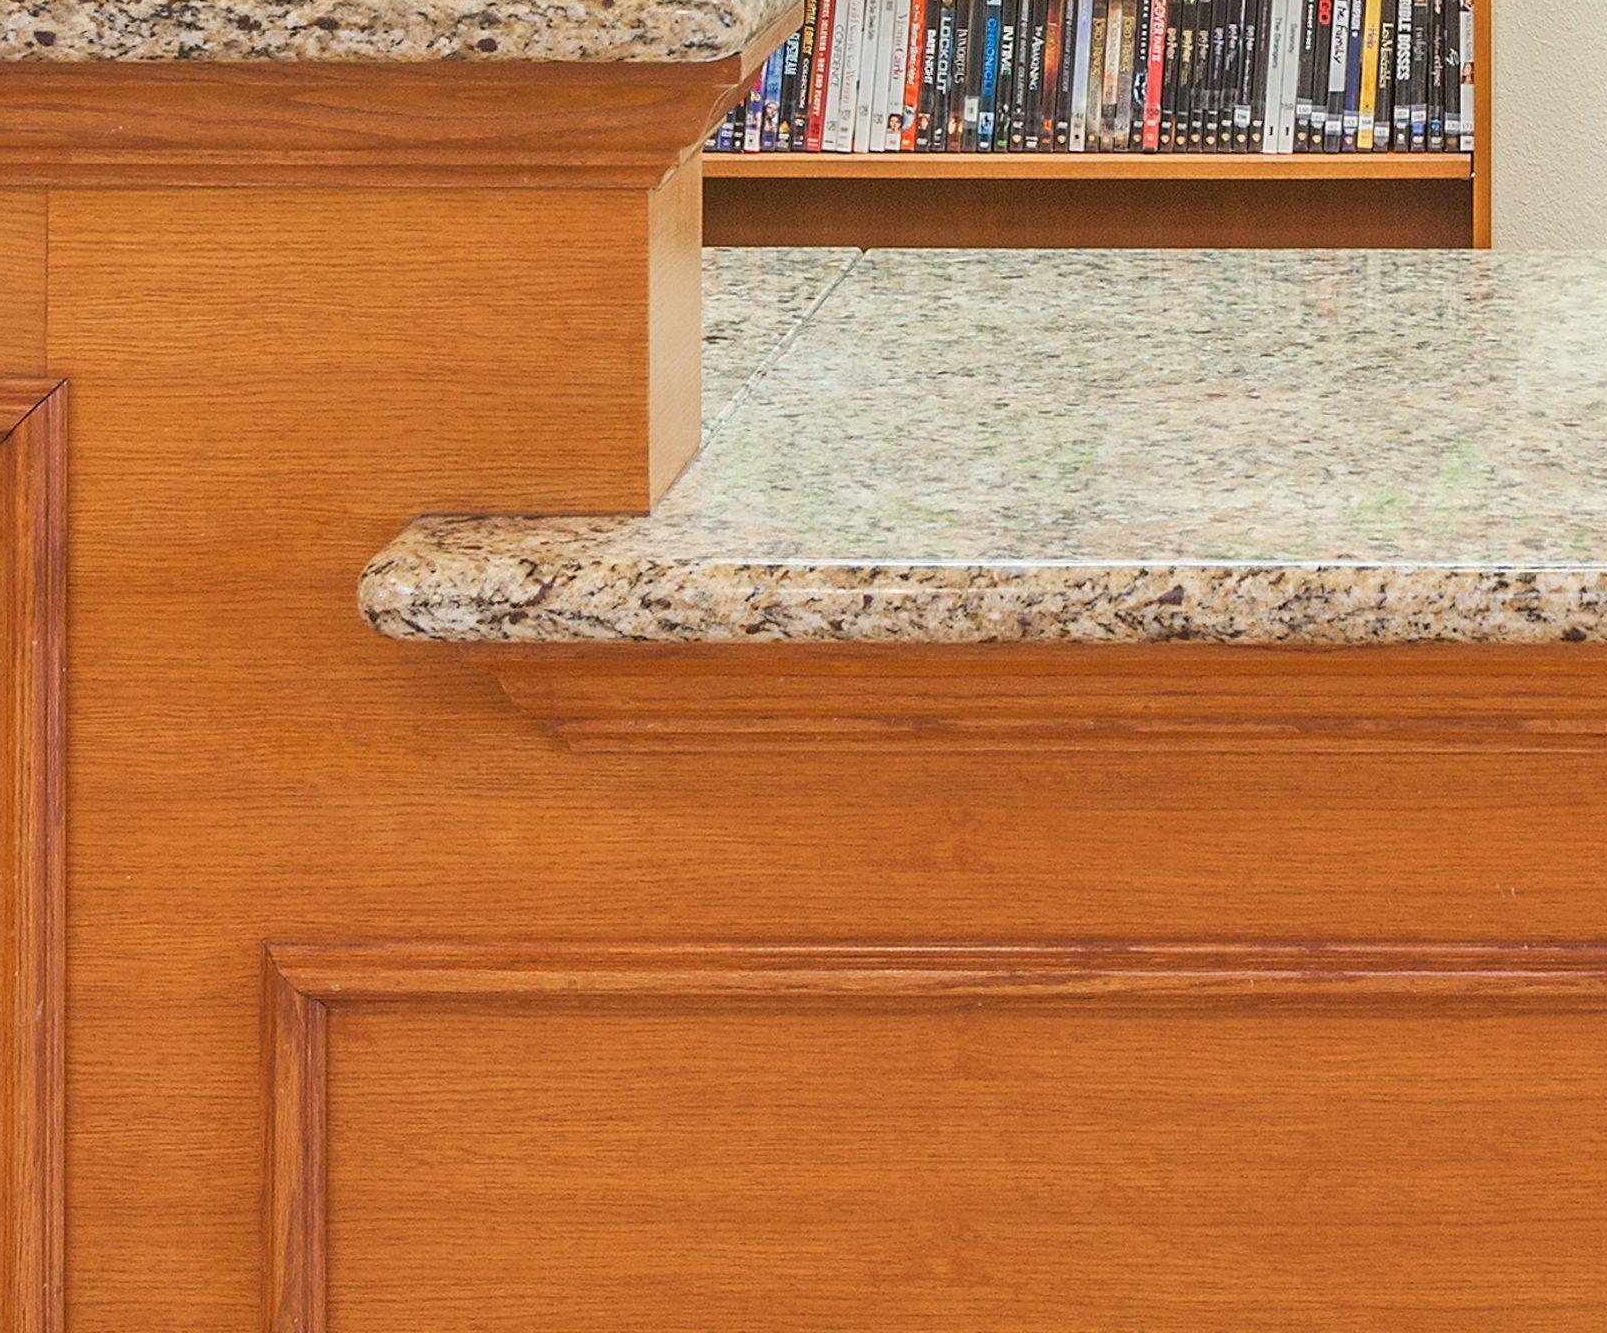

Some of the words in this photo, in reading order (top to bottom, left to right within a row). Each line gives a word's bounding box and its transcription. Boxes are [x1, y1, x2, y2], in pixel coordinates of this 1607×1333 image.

[1004, 25, 1014, 40] IN
[1274, 17, 1282, 31] The
[1288, 23, 1298, 53] Serenity
[830, 24, 843, 88] CONFIDENCE
[936, 16, 951, 94] LOCKOUT
[984, 17, 998, 97] CHRONICLE
[1001, 41, 1013, 75] TIME
[1270, 33, 1280, 69] Strangers
[1333, 25, 1347, 65] Family
[1396, 34, 1411, 80] BOSSES
[923, 56, 934, 85] NIGHT
